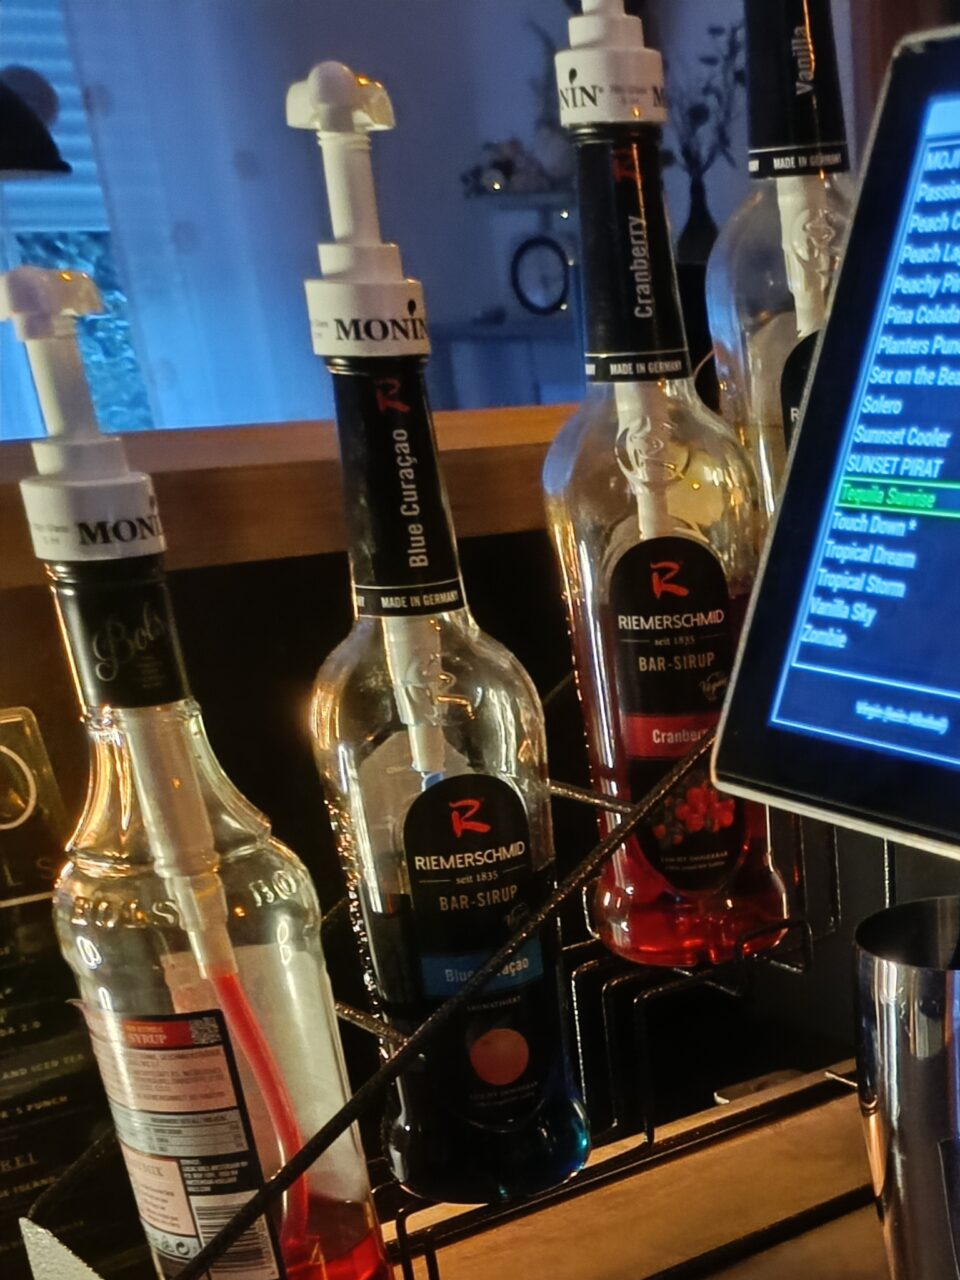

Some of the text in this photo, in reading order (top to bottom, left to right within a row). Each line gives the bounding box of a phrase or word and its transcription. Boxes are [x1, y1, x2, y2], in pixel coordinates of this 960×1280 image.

[792, 26, 814, 95] Vanilla
[773, 156, 796, 171] MADE
[908, 210, 949, 233] Peach
[900, 242, 941, 264] Peach
[628, 216, 654, 318] Cranberry
[892, 274, 940, 298] Peachy
[610, 363, 634, 376] MADE
[636, 362, 646, 374] IN
[869, 366, 893, 385] Sex
[895, 369, 912, 385] on
[913, 366, 936, 385] the
[861, 395, 903, 414] Solero
[846, 454, 945, 479] SUNSET PIRAT
[392, 428, 429, 569] Blue Curaçao
[381, 596, 409, 609] MADE
[410, 596, 421, 607] IN
[618, 609, 724, 631] RIEMERSCHMID
[652, 728, 709, 744] Cranber
[414, 841, 526, 873] RIEMERSCHMID
